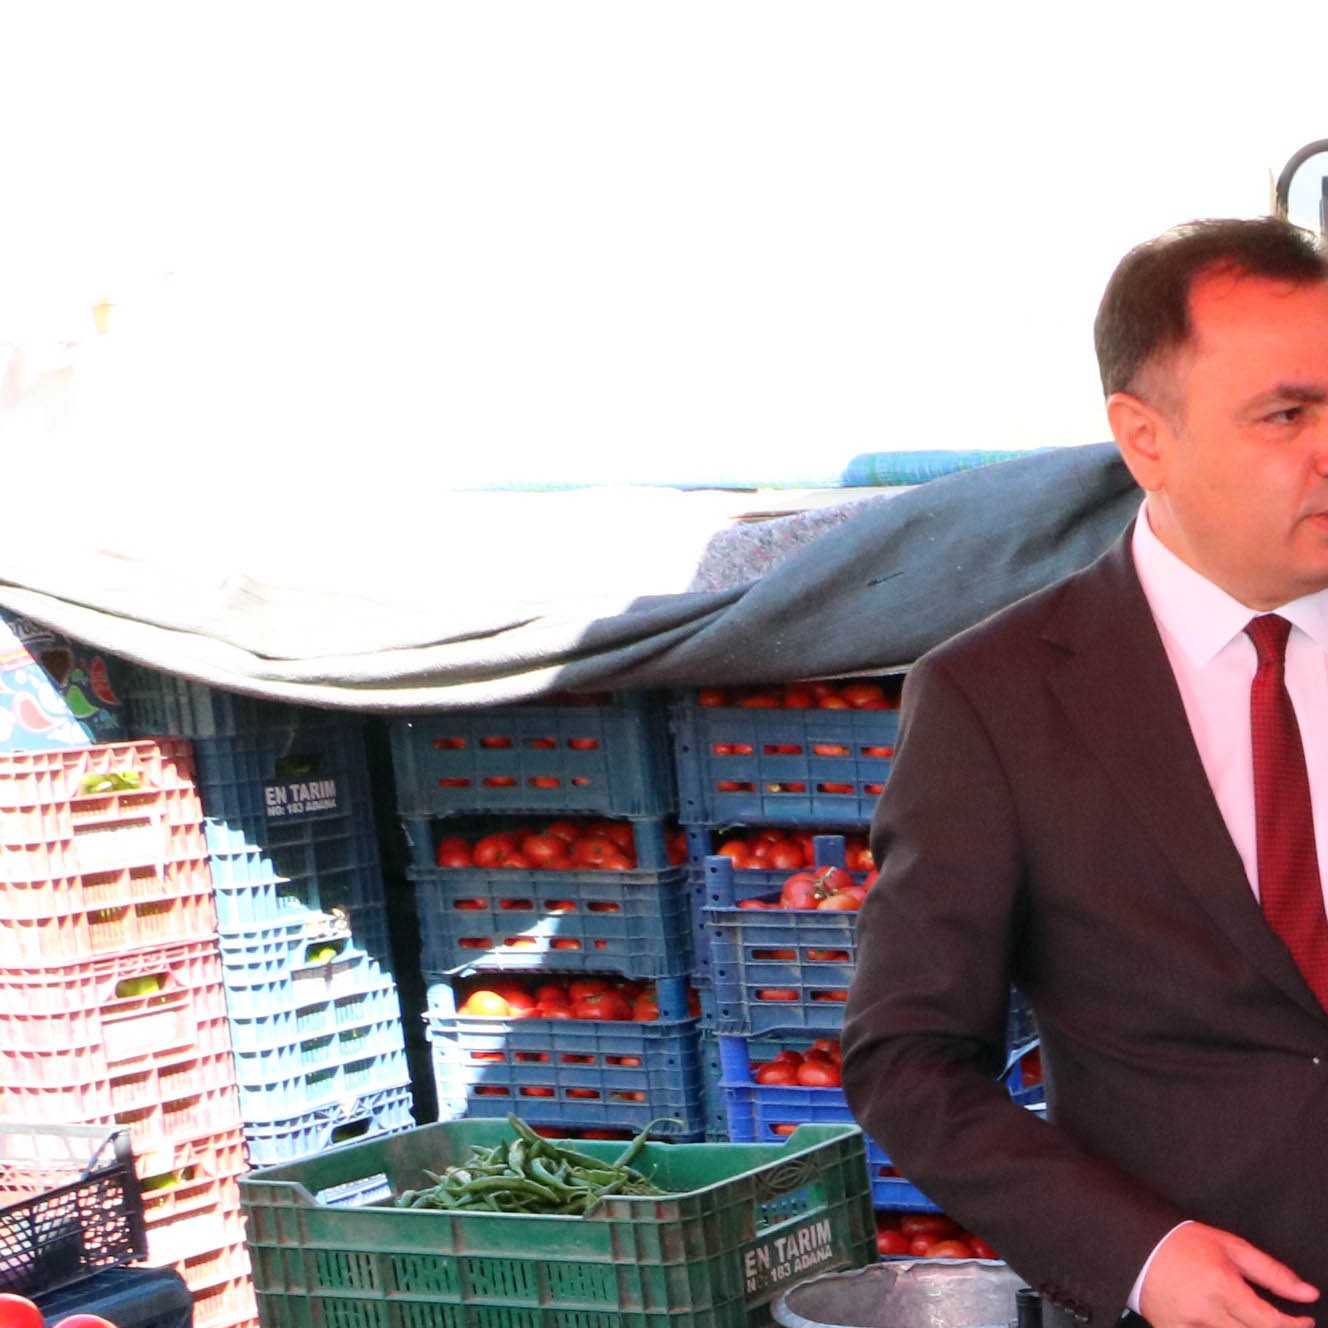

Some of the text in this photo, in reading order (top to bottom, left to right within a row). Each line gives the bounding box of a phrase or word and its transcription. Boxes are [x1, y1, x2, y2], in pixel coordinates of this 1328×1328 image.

[264, 780, 337, 806] EN TARIM
[744, 1219, 832, 1278] EN TARIM
[794, 1245, 833, 1273] ADANA
